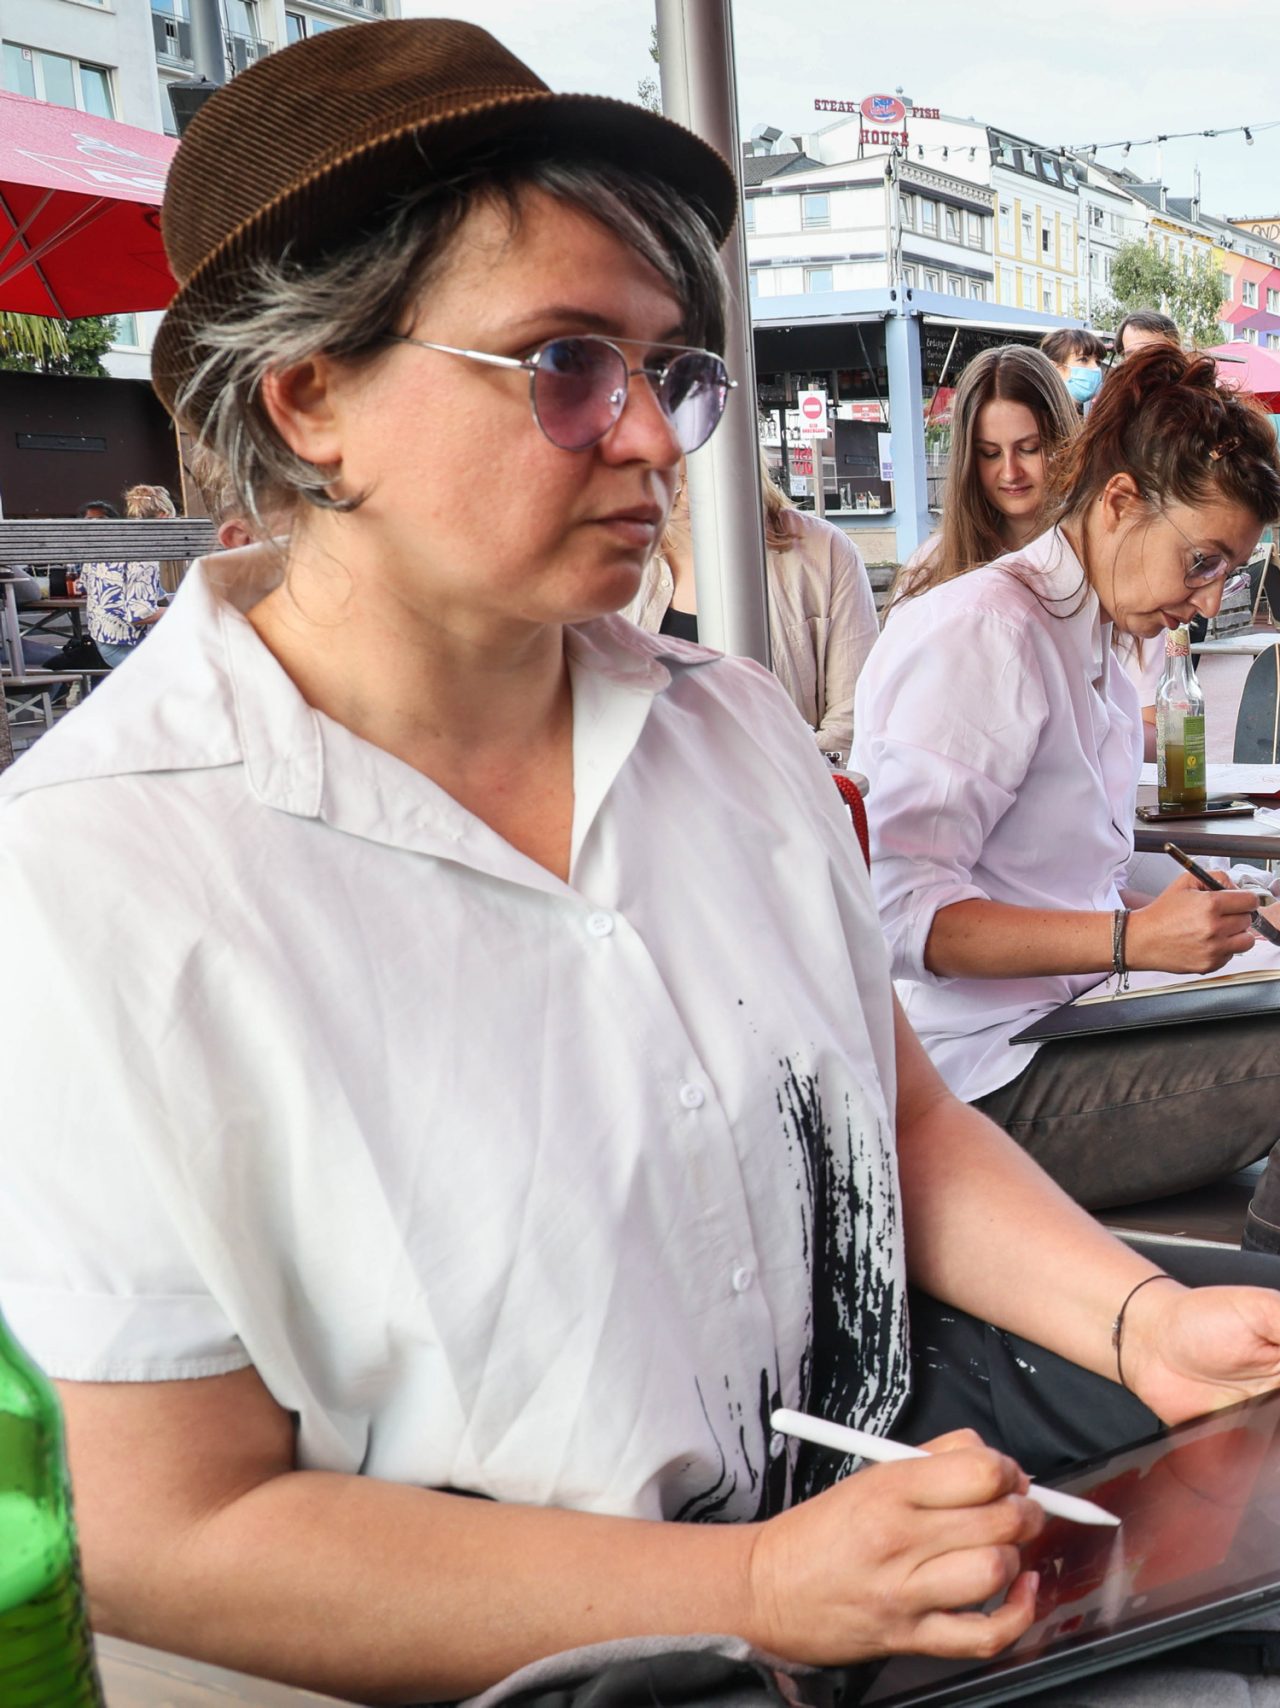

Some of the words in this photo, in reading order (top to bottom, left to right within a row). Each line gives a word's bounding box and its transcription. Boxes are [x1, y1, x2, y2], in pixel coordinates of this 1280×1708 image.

[814, 99, 856, 112] STEAK
[912, 107, 940, 119] FISH
[860, 129, 909, 147] HOUSE
